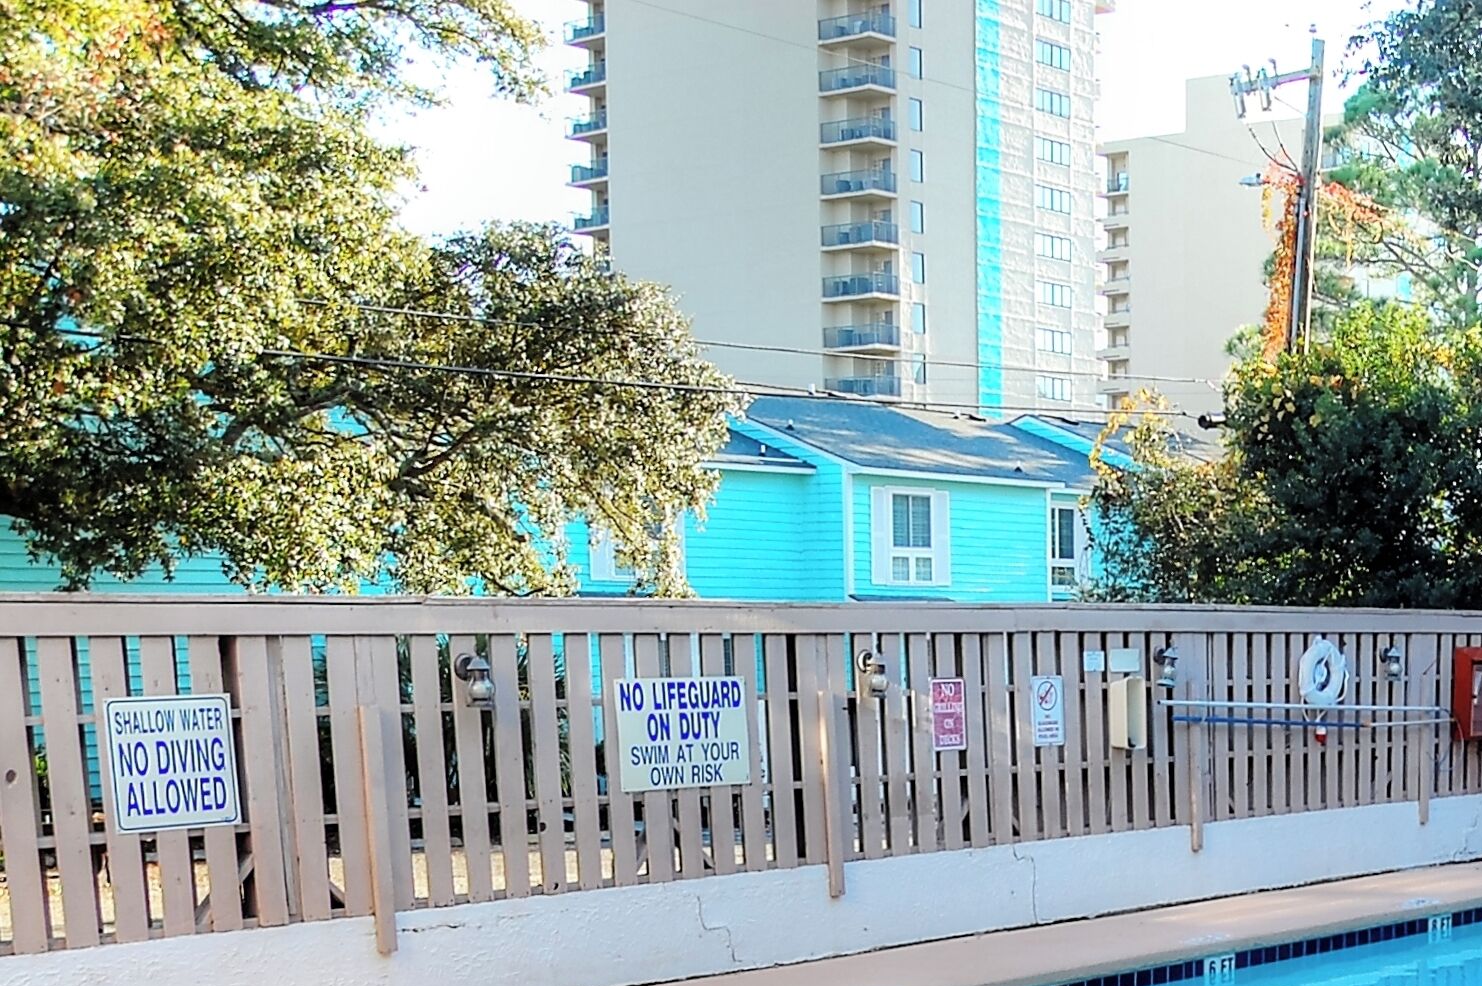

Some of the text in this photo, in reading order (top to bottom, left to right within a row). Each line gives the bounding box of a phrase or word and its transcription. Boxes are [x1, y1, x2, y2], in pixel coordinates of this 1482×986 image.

[619, 680, 741, 711] NO LIFEGUARD
[114, 707, 223, 735] SHALLOW WATER
[647, 711, 720, 741] ON DUTY
[118, 737, 226, 777] NO DIVING
[631, 742, 740, 766] SWIM AT YOUR
[650, 763, 723, 786] OWN RISK
[127, 776, 227, 817] ALLOWED
[1209, 957, 1233, 974] 6 FT
